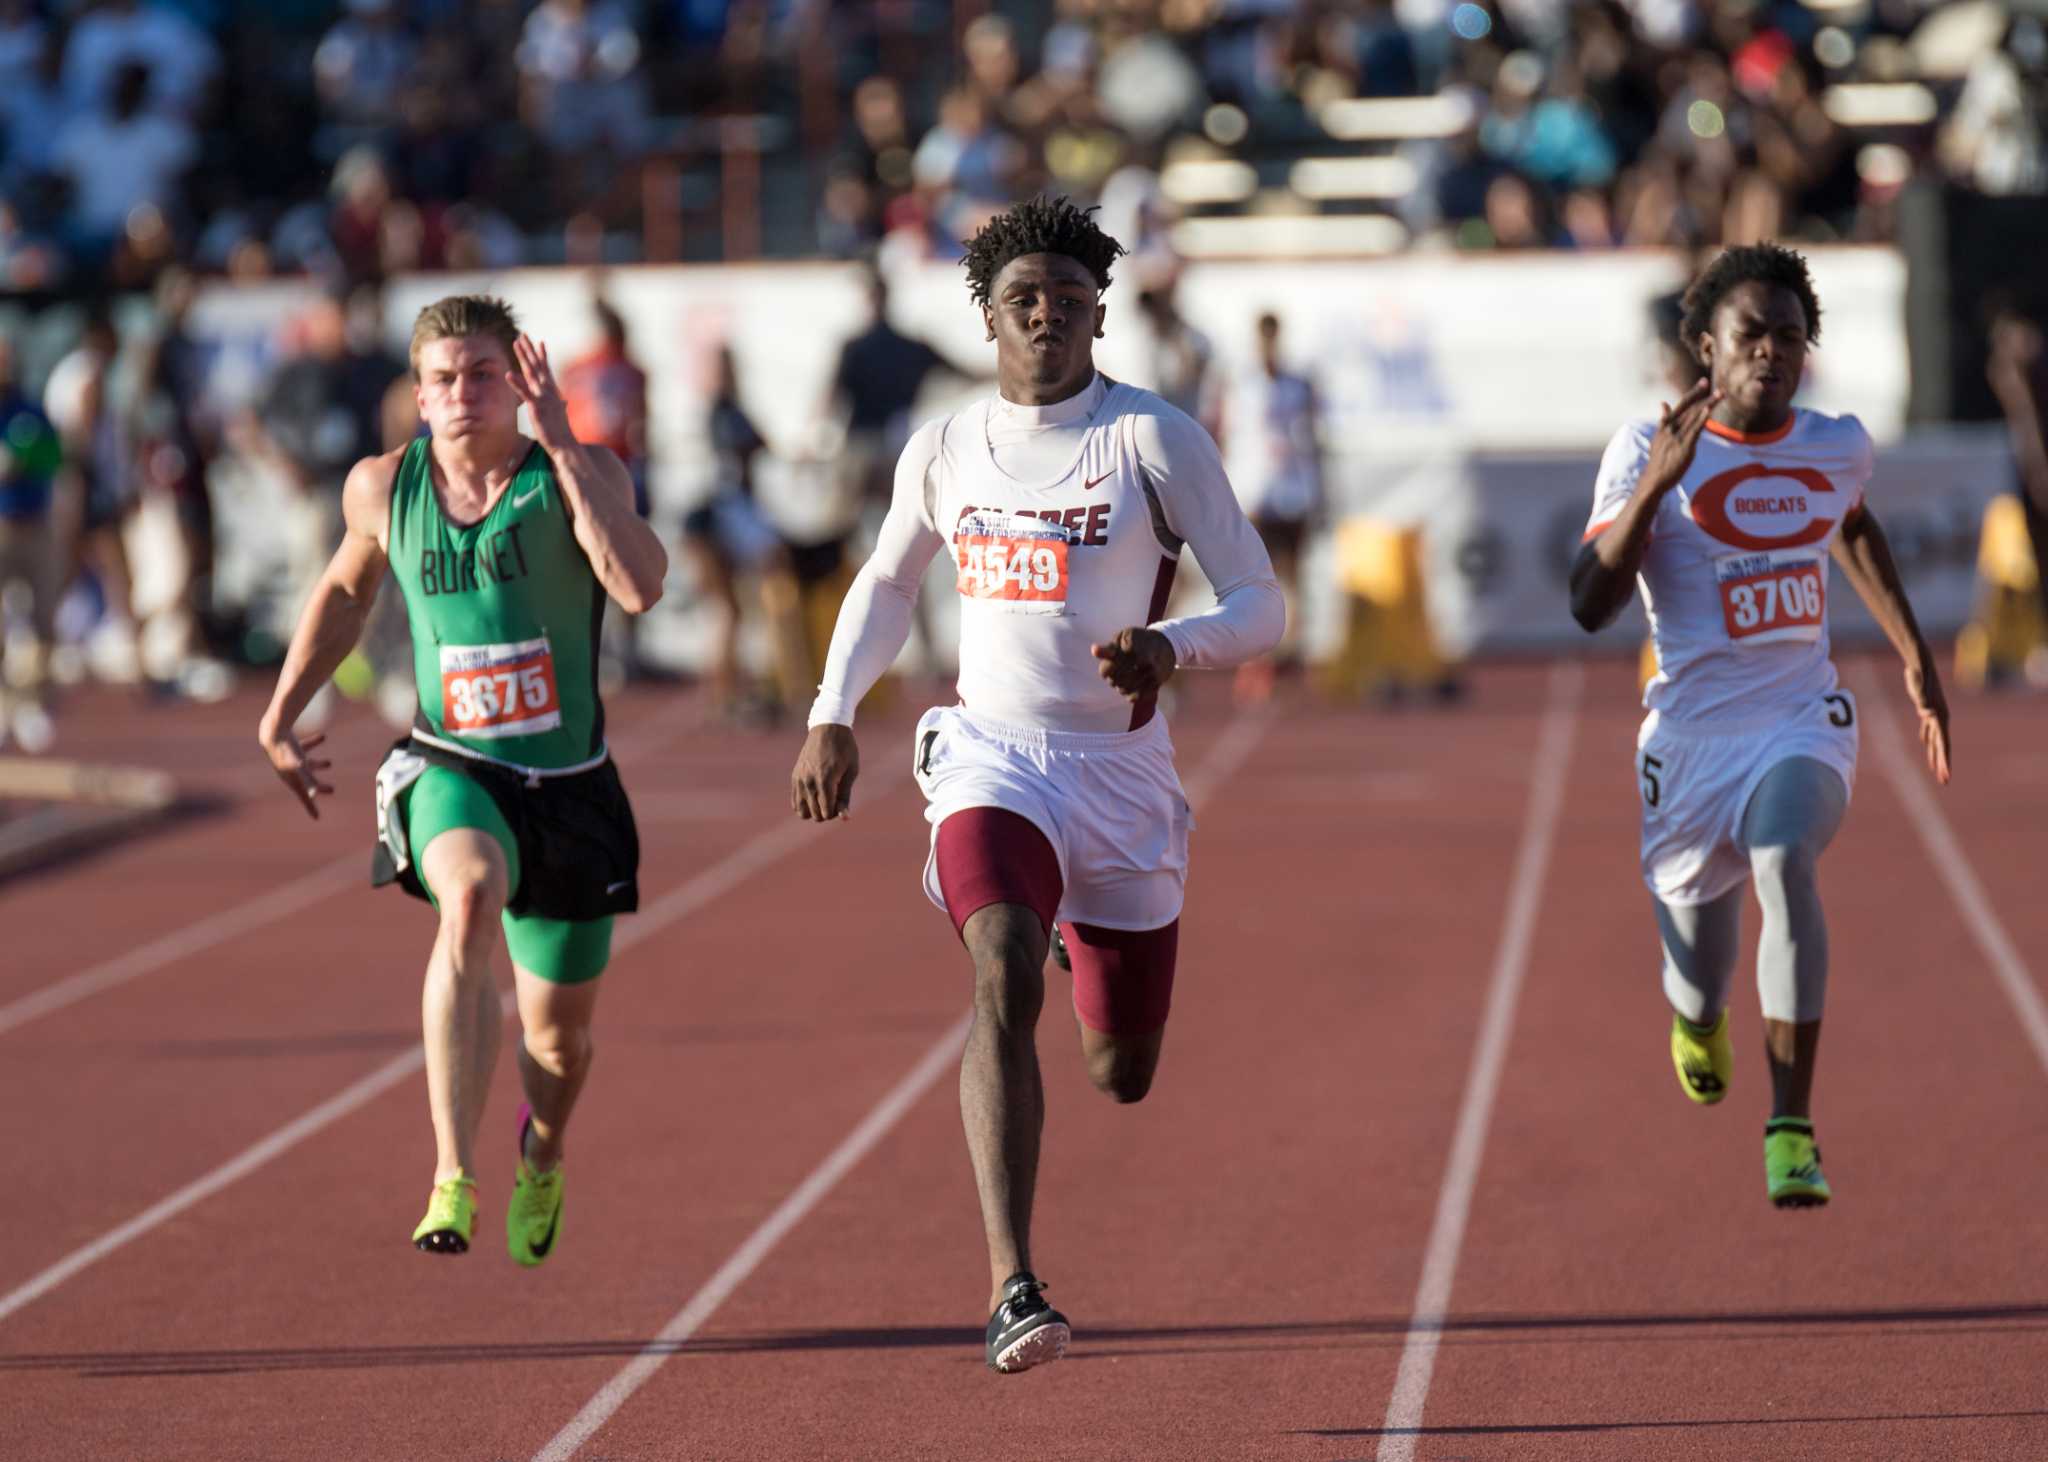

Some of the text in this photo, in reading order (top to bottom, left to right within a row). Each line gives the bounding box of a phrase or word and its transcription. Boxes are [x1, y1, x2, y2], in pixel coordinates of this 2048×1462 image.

[1691, 462, 1836, 551] C
[1734, 496, 1808, 513] BOBCATS
[421, 522, 529, 596] BURNET
[962, 545, 1060, 593] 4549
[1729, 573, 1820, 629] 3706
[449, 665, 550, 722] 3675
[1643, 754, 1663, 807] 5
